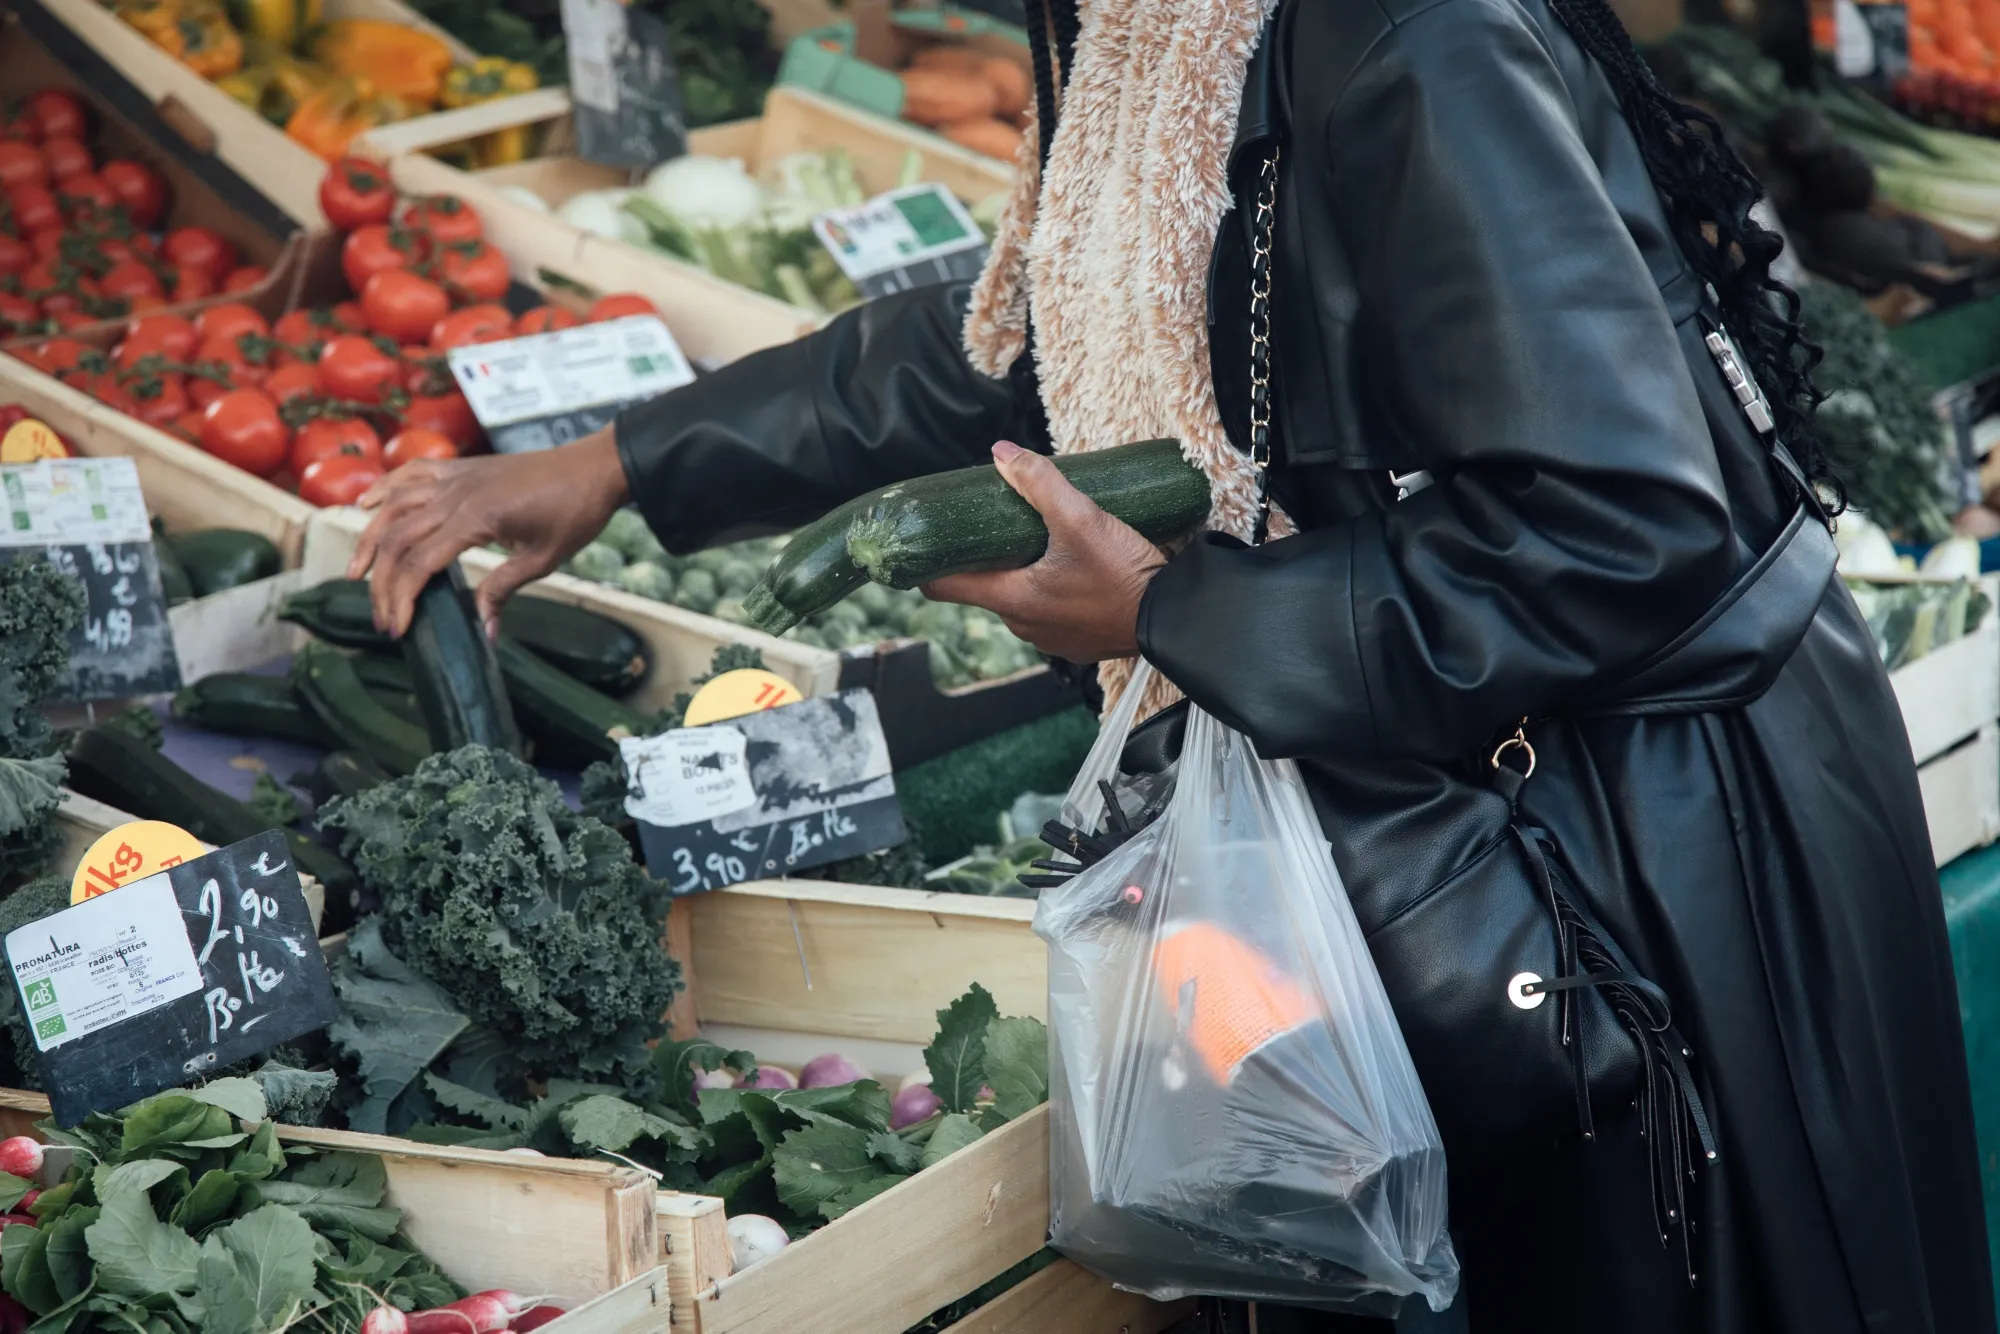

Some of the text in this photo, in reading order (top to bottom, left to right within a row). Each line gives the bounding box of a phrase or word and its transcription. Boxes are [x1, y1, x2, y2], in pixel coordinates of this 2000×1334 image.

[130, 925, 137, 933] 2
[15, 942, 80, 973] PRONATURA
[31, 986, 52, 1009] AB
